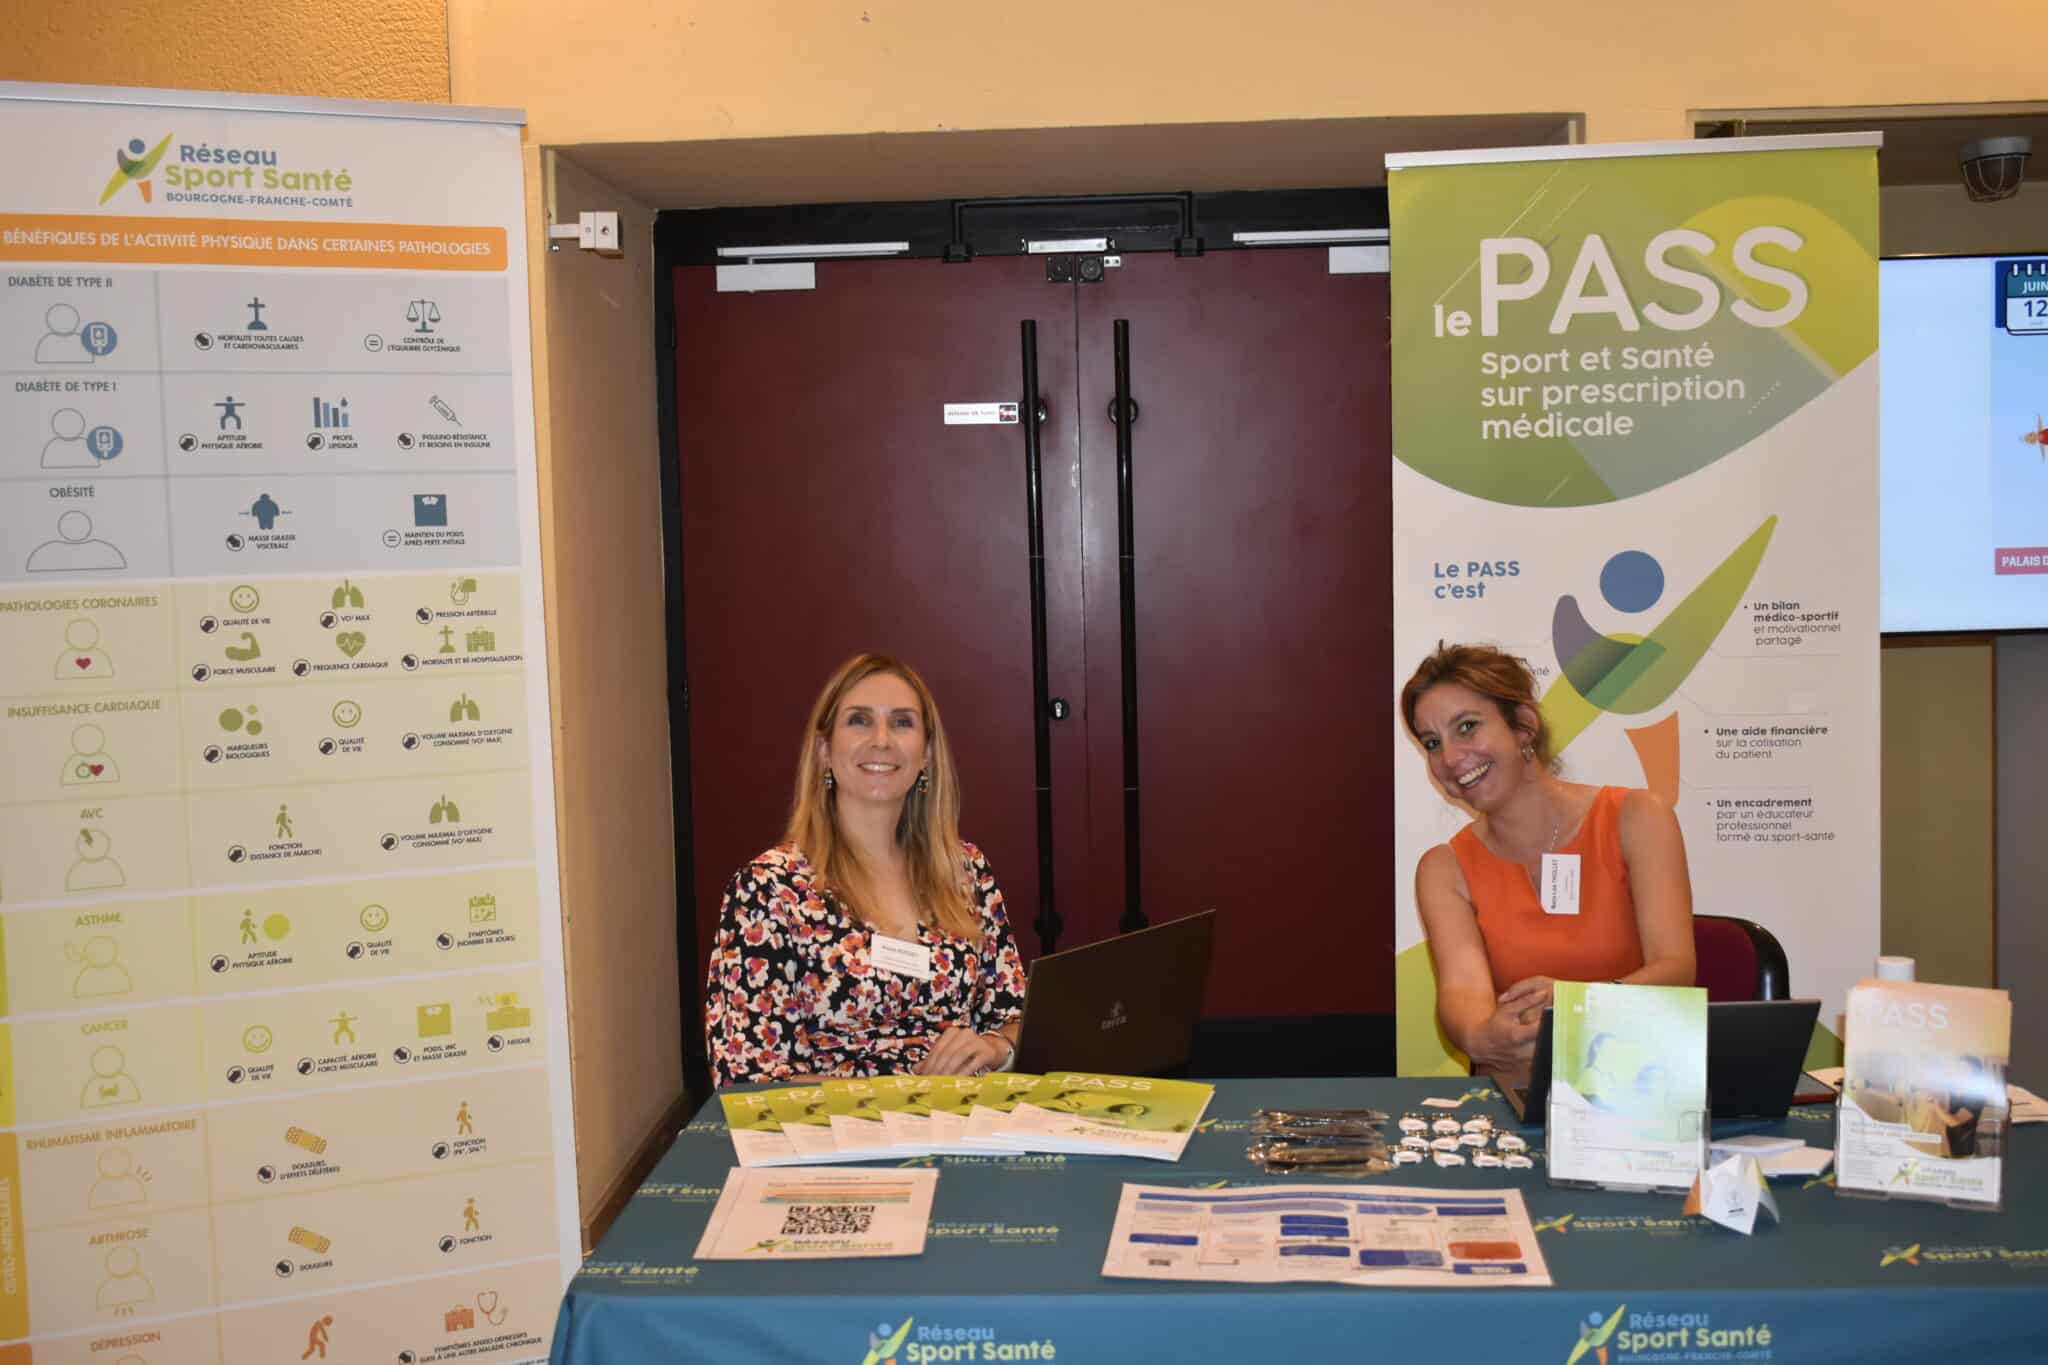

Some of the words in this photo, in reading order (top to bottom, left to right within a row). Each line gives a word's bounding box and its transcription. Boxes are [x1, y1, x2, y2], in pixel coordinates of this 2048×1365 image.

[181, 143, 277, 166] Réseau
[166, 166, 253, 190] Sport
[264, 168, 352, 192] Santé
[3, 228, 96, 247] BÉNÉFIQUES
[100, 232, 120, 247] DE
[124, 231, 197, 248] L'ACTIVITÉ
[201, 234, 273, 250] PHYSIQUE
[277, 237, 318, 251] DANS
[322, 238, 394, 253] CERTAINES
[399, 240, 491, 256] PATHOLOGIES
[8, 275, 54, 288] DIABÈTE
[58, 276, 73, 287] DE
[76, 277, 103, 288] TYPE
[1480, 226, 1809, 337] PASS
[2023, 300, 2047, 318] 12
[1433, 304, 1472, 337] le
[1481, 348, 1569, 379] Sport
[1580, 348, 1612, 373] et
[1622, 342, 1715, 370] Santé
[15, 380, 61, 393] DIABÈTE
[64, 381, 80, 393] DE
[83, 381, 110, 393] TYPE
[112, 381, 117, 392] I
[1481, 386, 1532, 408] sur
[1542, 375, 1745, 411] prescription
[1481, 411, 1634, 440] médicale
[49, 485, 95, 498] OBÉSITÉ
[1434, 562, 1460, 578] Le
[1467, 560, 1520, 578] PASS
[2001, 556, 2040, 567] PALAIS
[1434, 581, 1487, 599] c'est
[82, 595, 159, 610] CORONAIRES
[1753, 601, 1768, 611] Un
[1771, 600, 1801, 611] bilan
[1753, 610, 1839, 623] médico-sportif
[1753, 624, 1765, 634] et
[1767, 623, 1841, 634] motivationnel
[8, 703, 91, 719] INSUFFISANCE
[94, 699, 161, 714] CARDIAQUE
[1716, 726, 1738, 736] Une
[1741, 726, 1767, 736] aide
[1771, 725, 1828, 736] financière
[1716, 739, 1733, 748] sur
[1736, 738, 1747, 748] la
[1749, 737, 1802, 748] cotisation
[1715, 749, 1730, 760] du
[1732, 749, 1772, 761] patient
[1716, 799, 1732, 808] Un
[1734, 798, 1812, 808] encadrement
[80, 808, 104, 819] AVC
[1716, 810, 1737, 820] par
[1740, 810, 1754, 819] un
[1756, 808, 1815, 819] éducateur
[1716, 820, 1792, 831] professionnel
[1754, 832, 1769, 842] au
[75, 912, 121, 927] ASTHME
[81, 1019, 128, 1035] CANCER
[1063, 1075, 1152, 1090] PASS
[25, 1130, 101, 1150] RHUMATISME
[105, 1119, 197, 1140] INFLAMMATOIRE
[88, 1228, 150, 1246] ARTHROSE
[992, 1225, 1059, 1235] Santé
[630, 1266, 699, 1275] Santé
[1629, 1312, 1709, 1330] Réseau
[918, 1324, 995, 1342] Réseau
[1617, 1327, 1689, 1353] Sport
[1696, 1323, 1772, 1347] Santé
[906, 1341, 977, 1365] Sport
[983, 1339, 1056, 1361] Santé
